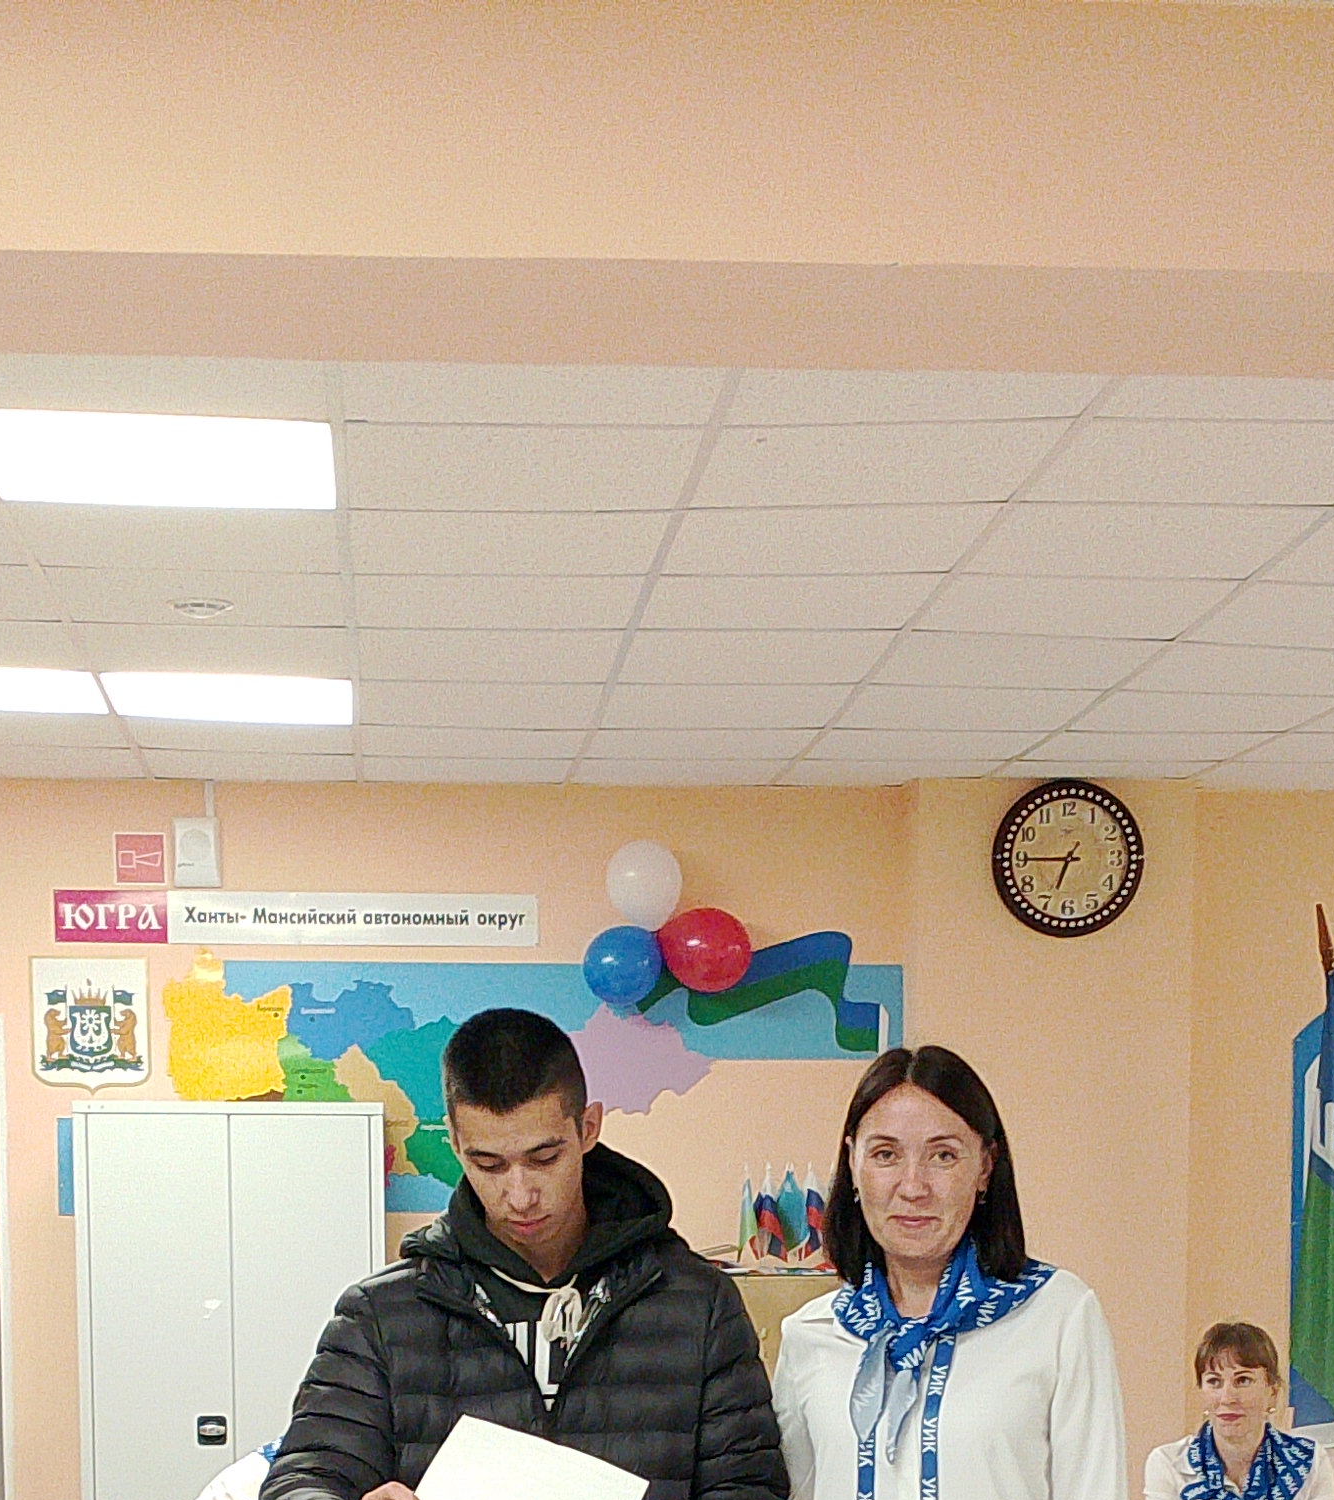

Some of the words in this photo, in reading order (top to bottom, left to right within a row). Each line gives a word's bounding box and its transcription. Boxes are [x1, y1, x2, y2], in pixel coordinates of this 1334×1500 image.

[1039, 808, 1051, 824] 11
[1062, 801, 1077, 817] 12
[1088, 807, 1096, 824] 1
[1020, 826, 1036, 842] 10
[1104, 825, 1118, 841] 2
[1015, 850, 1028, 868] 9
[1109, 849, 1123, 867] 3
[1020, 875, 1035, 893] 8
[1102, 874, 1114, 891] 4
[1037, 895, 1052, 911] 7
[1060, 899, 1076, 916] 6
[1085, 893, 1099, 910] 5
[62, 903, 162, 931] ЮГРА
[184, 906, 247, 925] Ханты-
[253, 907, 357, 926] Мансийский
[363, 908, 470, 927] автономный
[477, 910, 526, 930] округ
[927, 1364, 949, 1396] УИК
[921, 1417, 938, 1454] УИК
